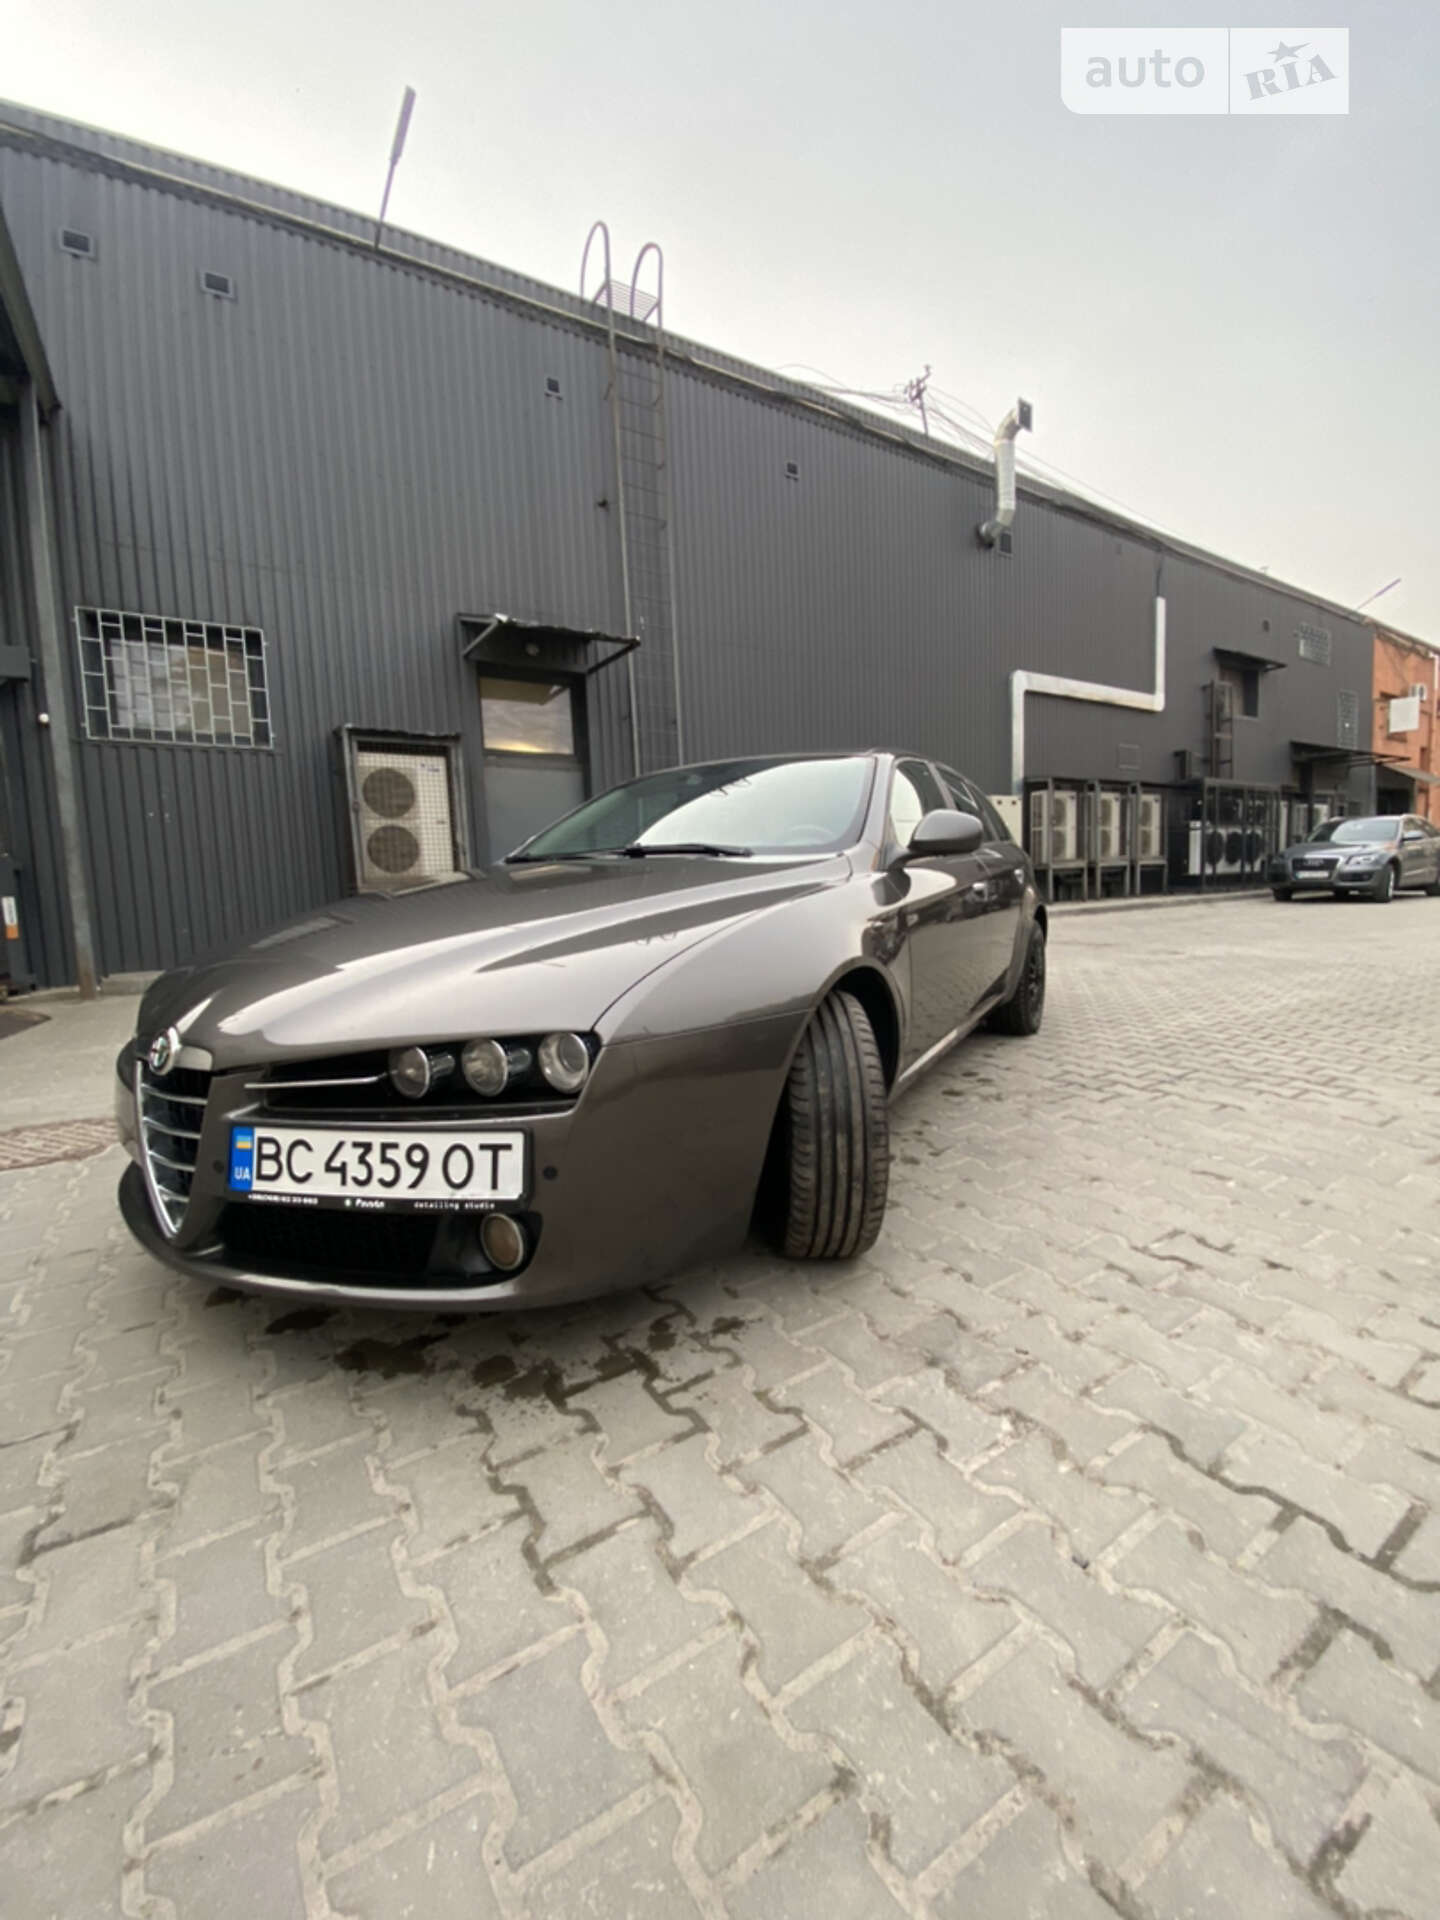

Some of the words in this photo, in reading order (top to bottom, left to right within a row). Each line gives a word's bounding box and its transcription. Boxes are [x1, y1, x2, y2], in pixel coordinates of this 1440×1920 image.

[233, 1166, 251, 1180] UA
[255, 1136, 314, 1184] BC
[324, 1140, 430, 1189] 4359
[441, 1142, 513, 1190] OT
